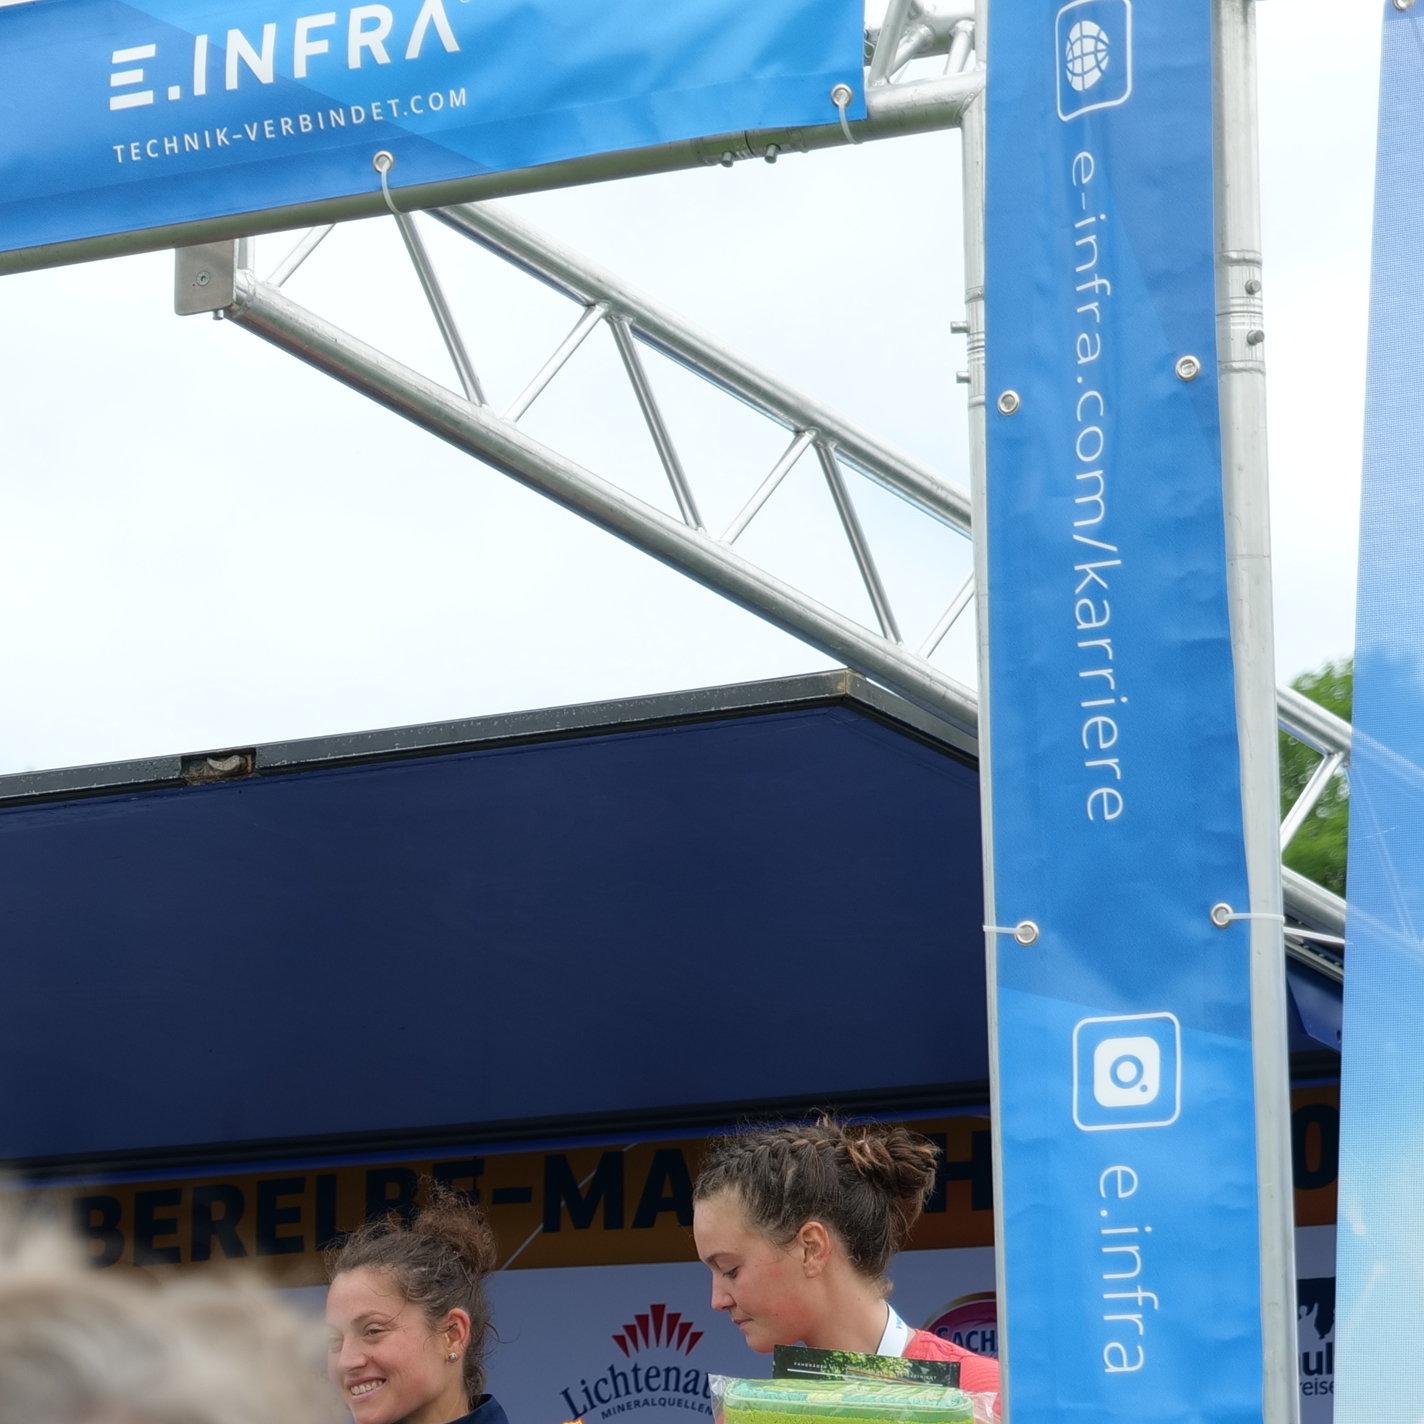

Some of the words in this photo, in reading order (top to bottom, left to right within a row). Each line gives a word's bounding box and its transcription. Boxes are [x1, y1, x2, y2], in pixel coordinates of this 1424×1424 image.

[109, 0, 462, 111] E.INFRA
[113, 88, 467, 163] TECHNIK-VERBINDET.COM
[1070, 150, 1133, 823] e-infra.com/karriere
[1098, 1163, 1159, 1375] e.infra
